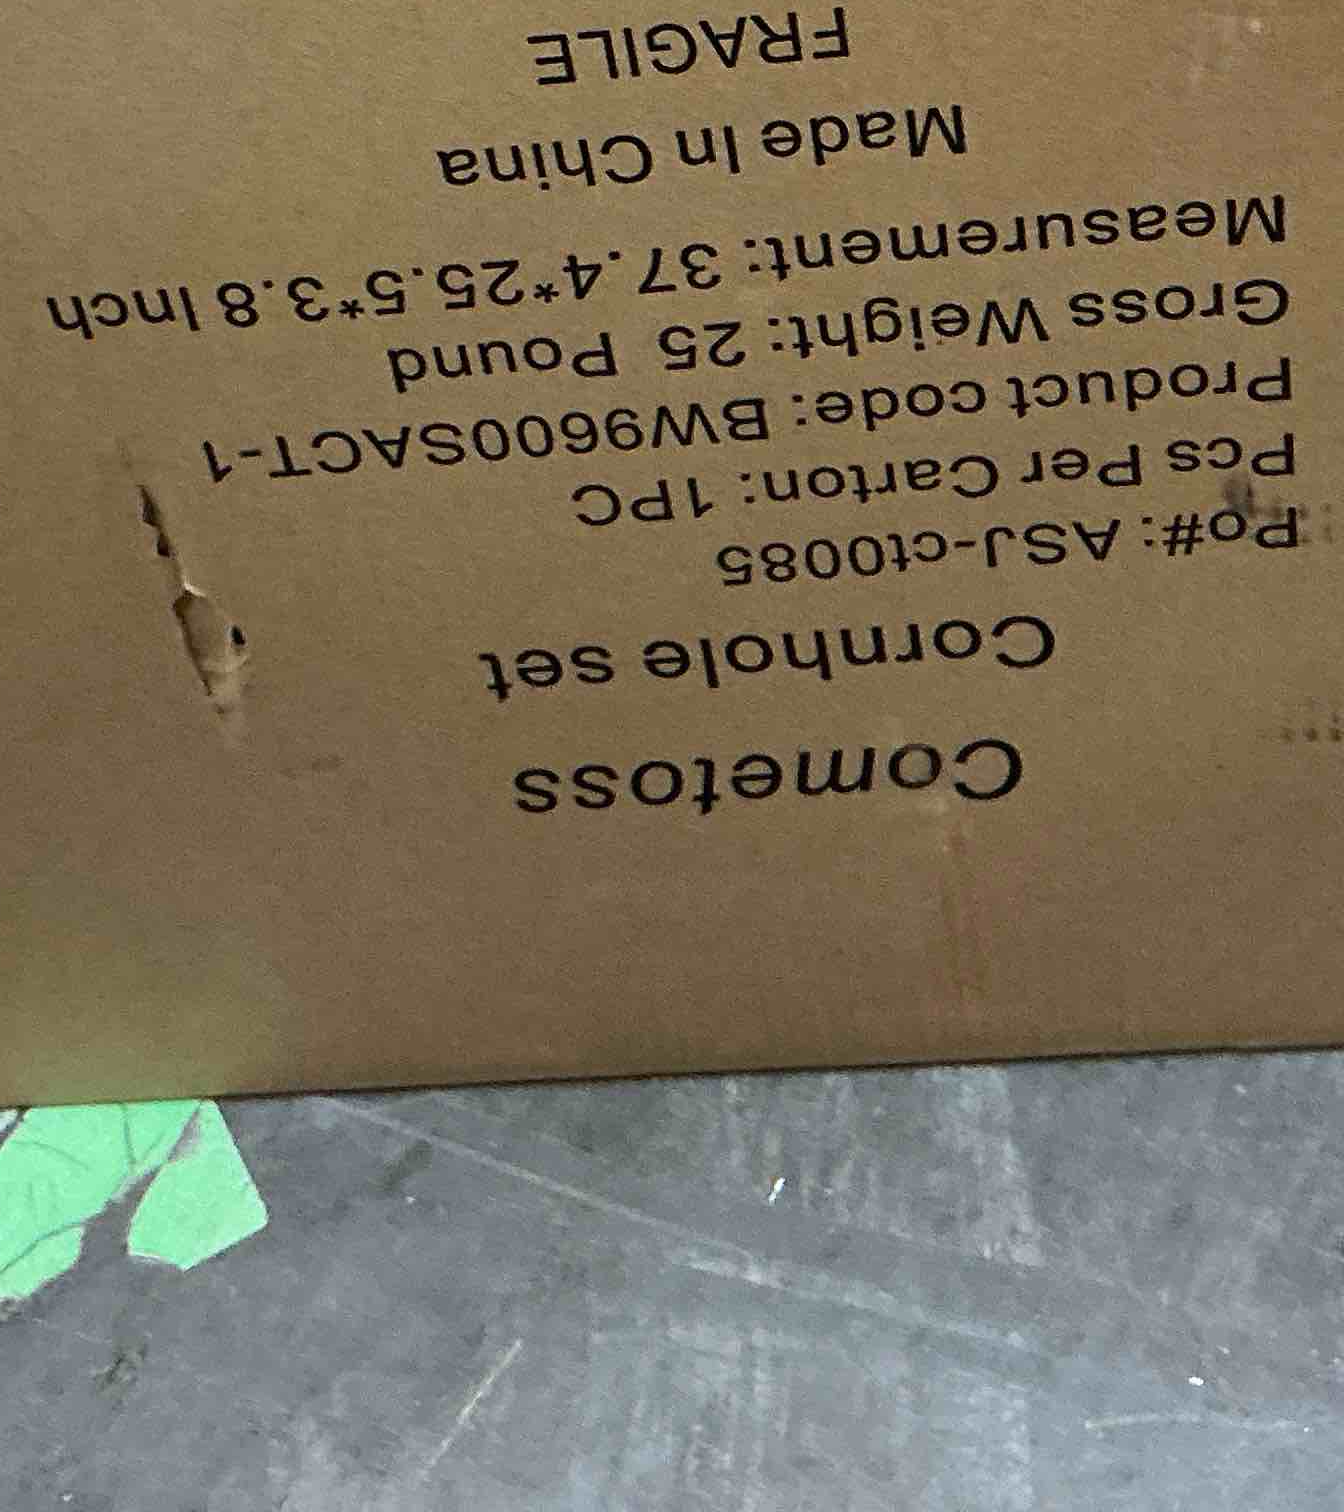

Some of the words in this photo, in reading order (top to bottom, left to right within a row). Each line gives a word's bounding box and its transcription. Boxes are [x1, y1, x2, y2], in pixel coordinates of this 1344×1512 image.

[526, 7, 851, 86] FRAGILE
[436, 133, 655, 191] China
[674, 125, 740, 175] In
[760, 103, 967, 167] Made
[743, 194, 1288, 282] Measurement:
[47, 285, 200, 341] Inch
[766, 296, 1051, 359] Weight:
[1067, 278, 1291, 328] Gross
[386, 331, 618, 394] Pound
[657, 320, 747, 371] 25
[792, 380, 987, 432] code:
[1008, 356, 1295, 419] Product
[201, 396, 770, 484] BW9600SACT-1
[1021, 443, 1143, 488] Per
[1166, 431, 1296, 477] Pcs
[570, 476, 714, 527] 1PC
[738, 453, 999, 505] Carton:
[716, 517, 1122, 587] ASJ-ct0085
[1141, 506, 1300, 557] Po#:
[478, 644, 615, 703] set
[642, 615, 1056, 689] Cornhole
[513, 738, 1023, 817] Cometoss
